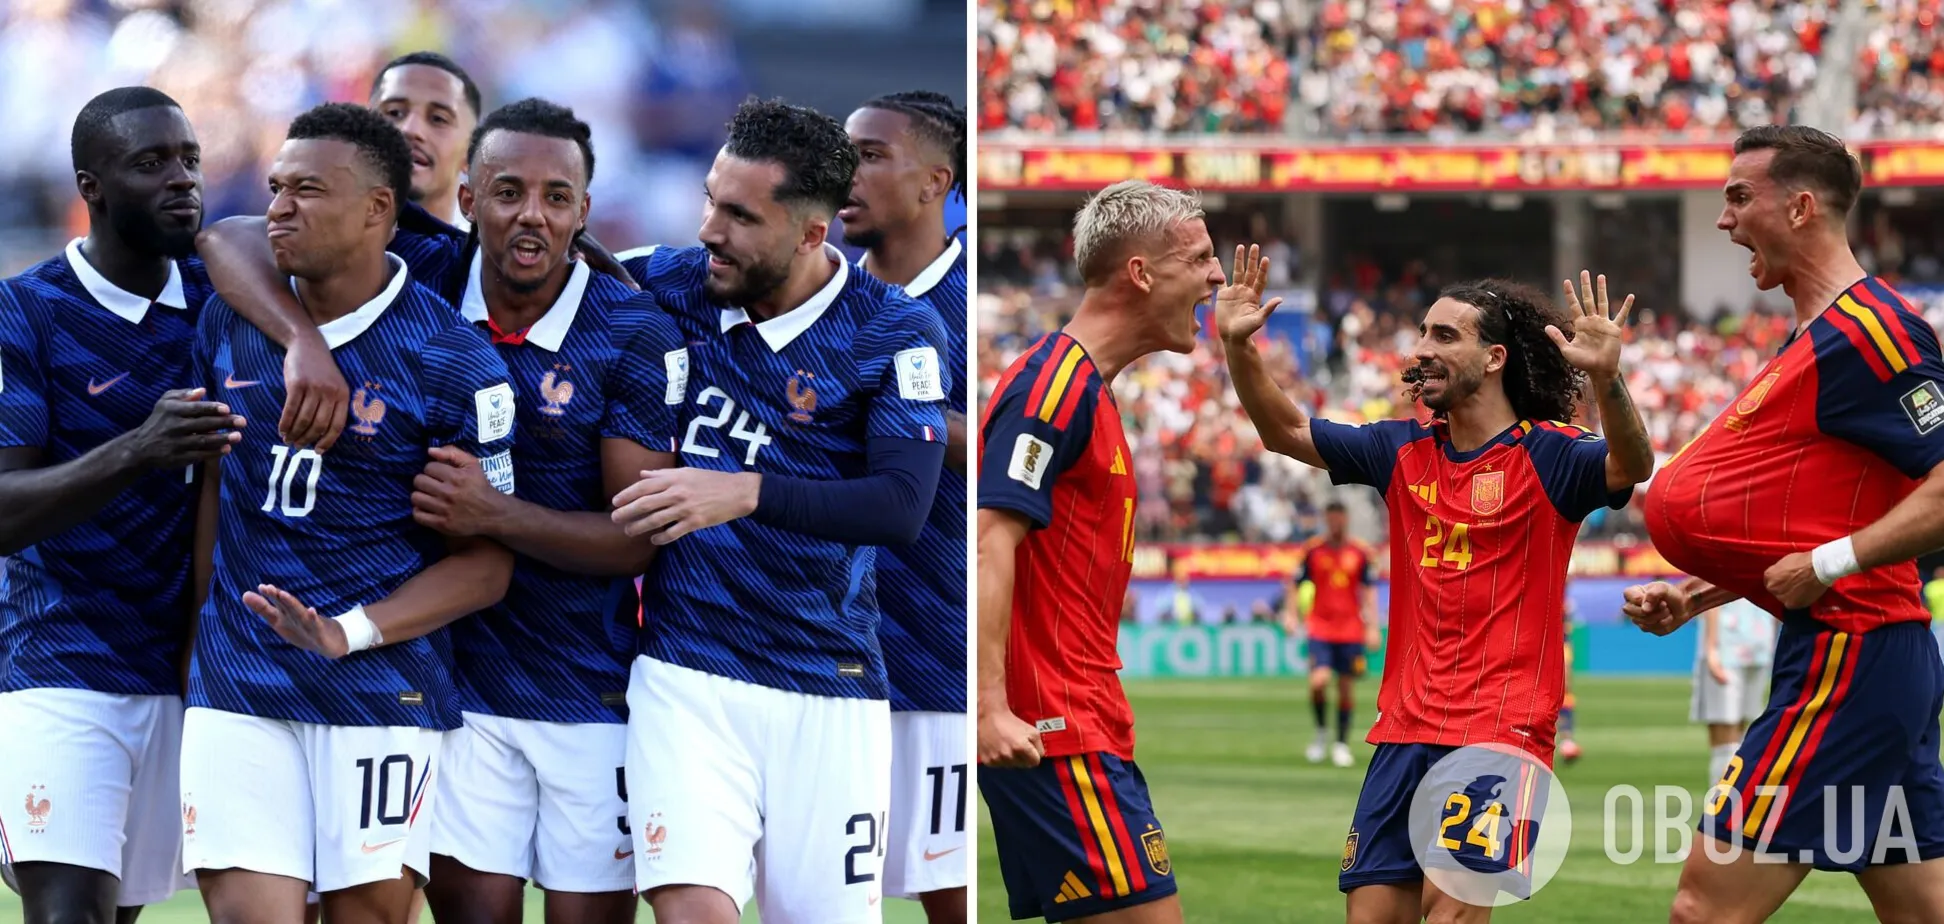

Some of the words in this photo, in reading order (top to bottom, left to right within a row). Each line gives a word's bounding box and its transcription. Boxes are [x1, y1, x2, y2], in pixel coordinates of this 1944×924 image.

[681, 386, 772, 465] 24
[261, 445, 322, 517] 10
[480, 453, 512, 472] UNITE
[1121, 498, 1133, 564] 1
[1420, 515, 1472, 570] 24
[356, 754, 413, 829] 10
[926, 764, 967, 834] 11
[1436, 792, 1501, 857] 24
